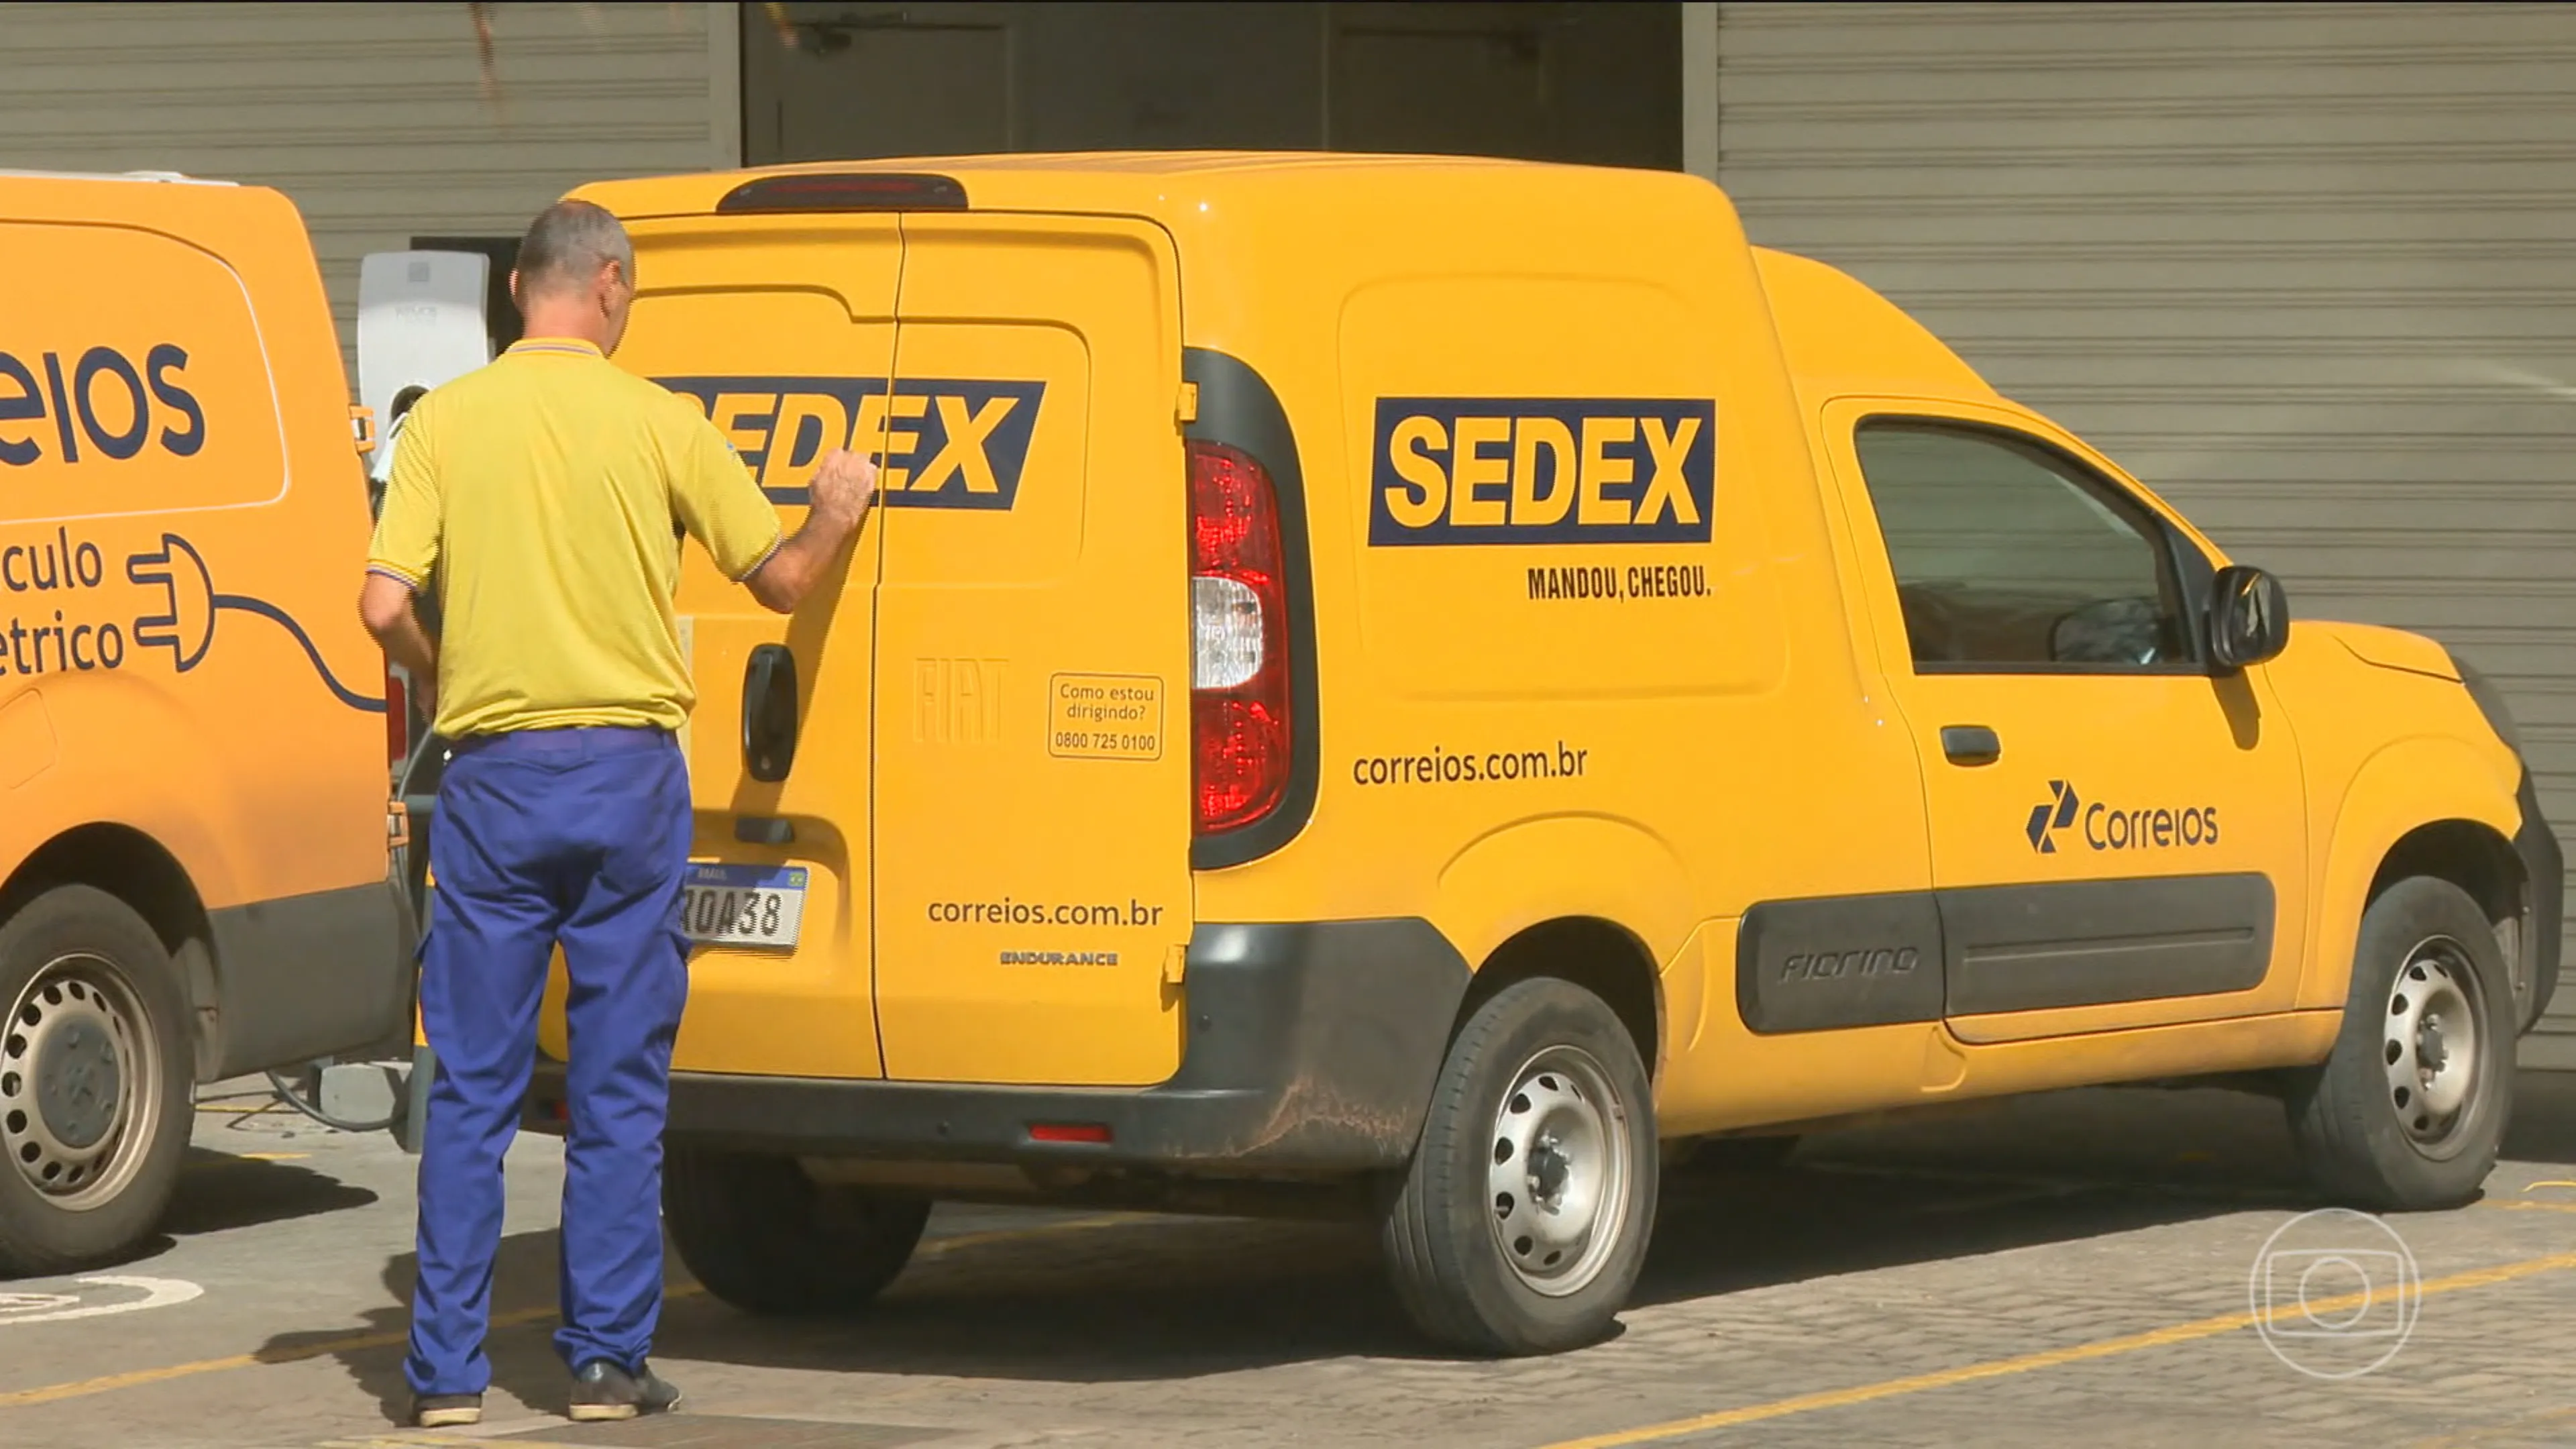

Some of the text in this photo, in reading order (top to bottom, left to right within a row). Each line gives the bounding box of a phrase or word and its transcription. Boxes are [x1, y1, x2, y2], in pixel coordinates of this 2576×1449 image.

[673, 392, 1020, 494] EDEX
[1385, 415, 1702, 528] SEDEX
[2, 526, 102, 592] culo
[913, 657, 1010, 743] FIAT
[1060, 683, 1154, 701] Como estou
[1067, 702, 1146, 722] dirigindo?
[1055, 732, 1155, 751] 0800 725 0100
[1353, 741, 1588, 785] correios.com.br
[2085, 802, 2218, 850] Correios
[928, 897, 1163, 926] correios.com.br
[1000, 951, 1118, 966] ENDURANCE
